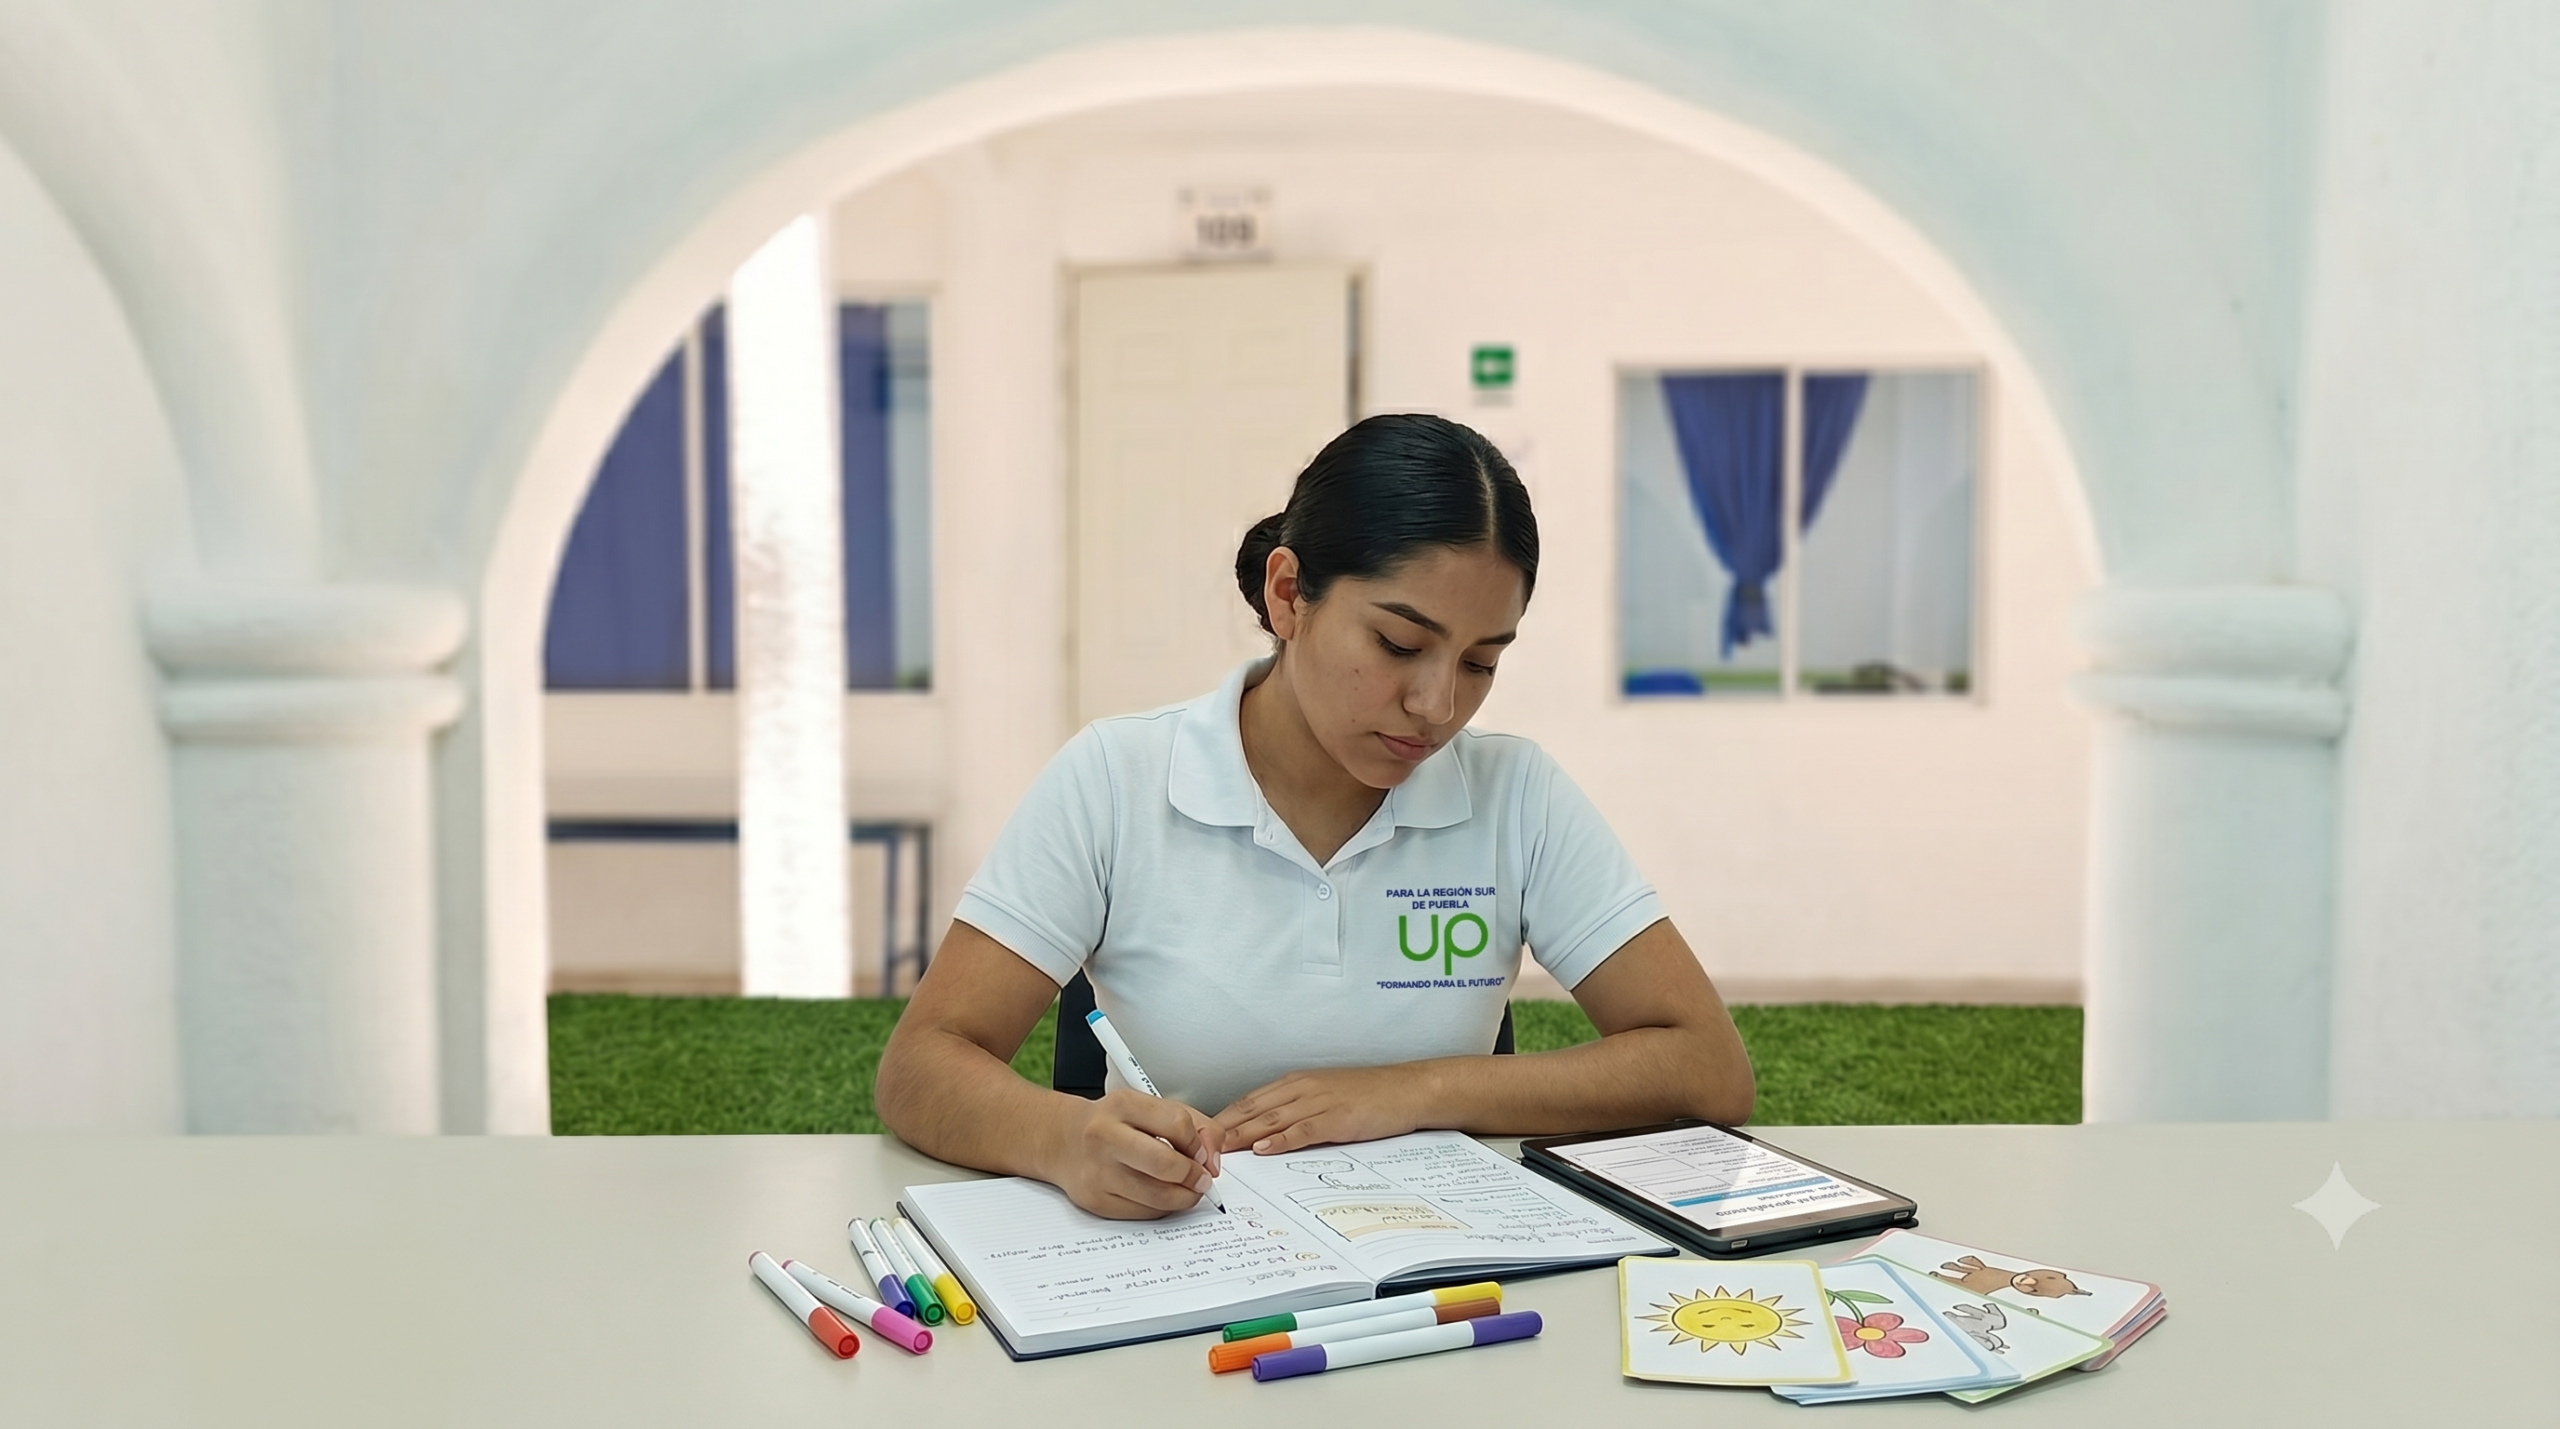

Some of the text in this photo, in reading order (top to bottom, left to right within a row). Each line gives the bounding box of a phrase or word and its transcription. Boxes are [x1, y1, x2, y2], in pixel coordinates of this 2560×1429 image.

[1386, 886, 1496, 898] PARA LA REGIÓN SUR
[1411, 900, 1425, 910] DE
[1432, 980, 1456, 988] PARA
[1457, 979, 1467, 988] EL
